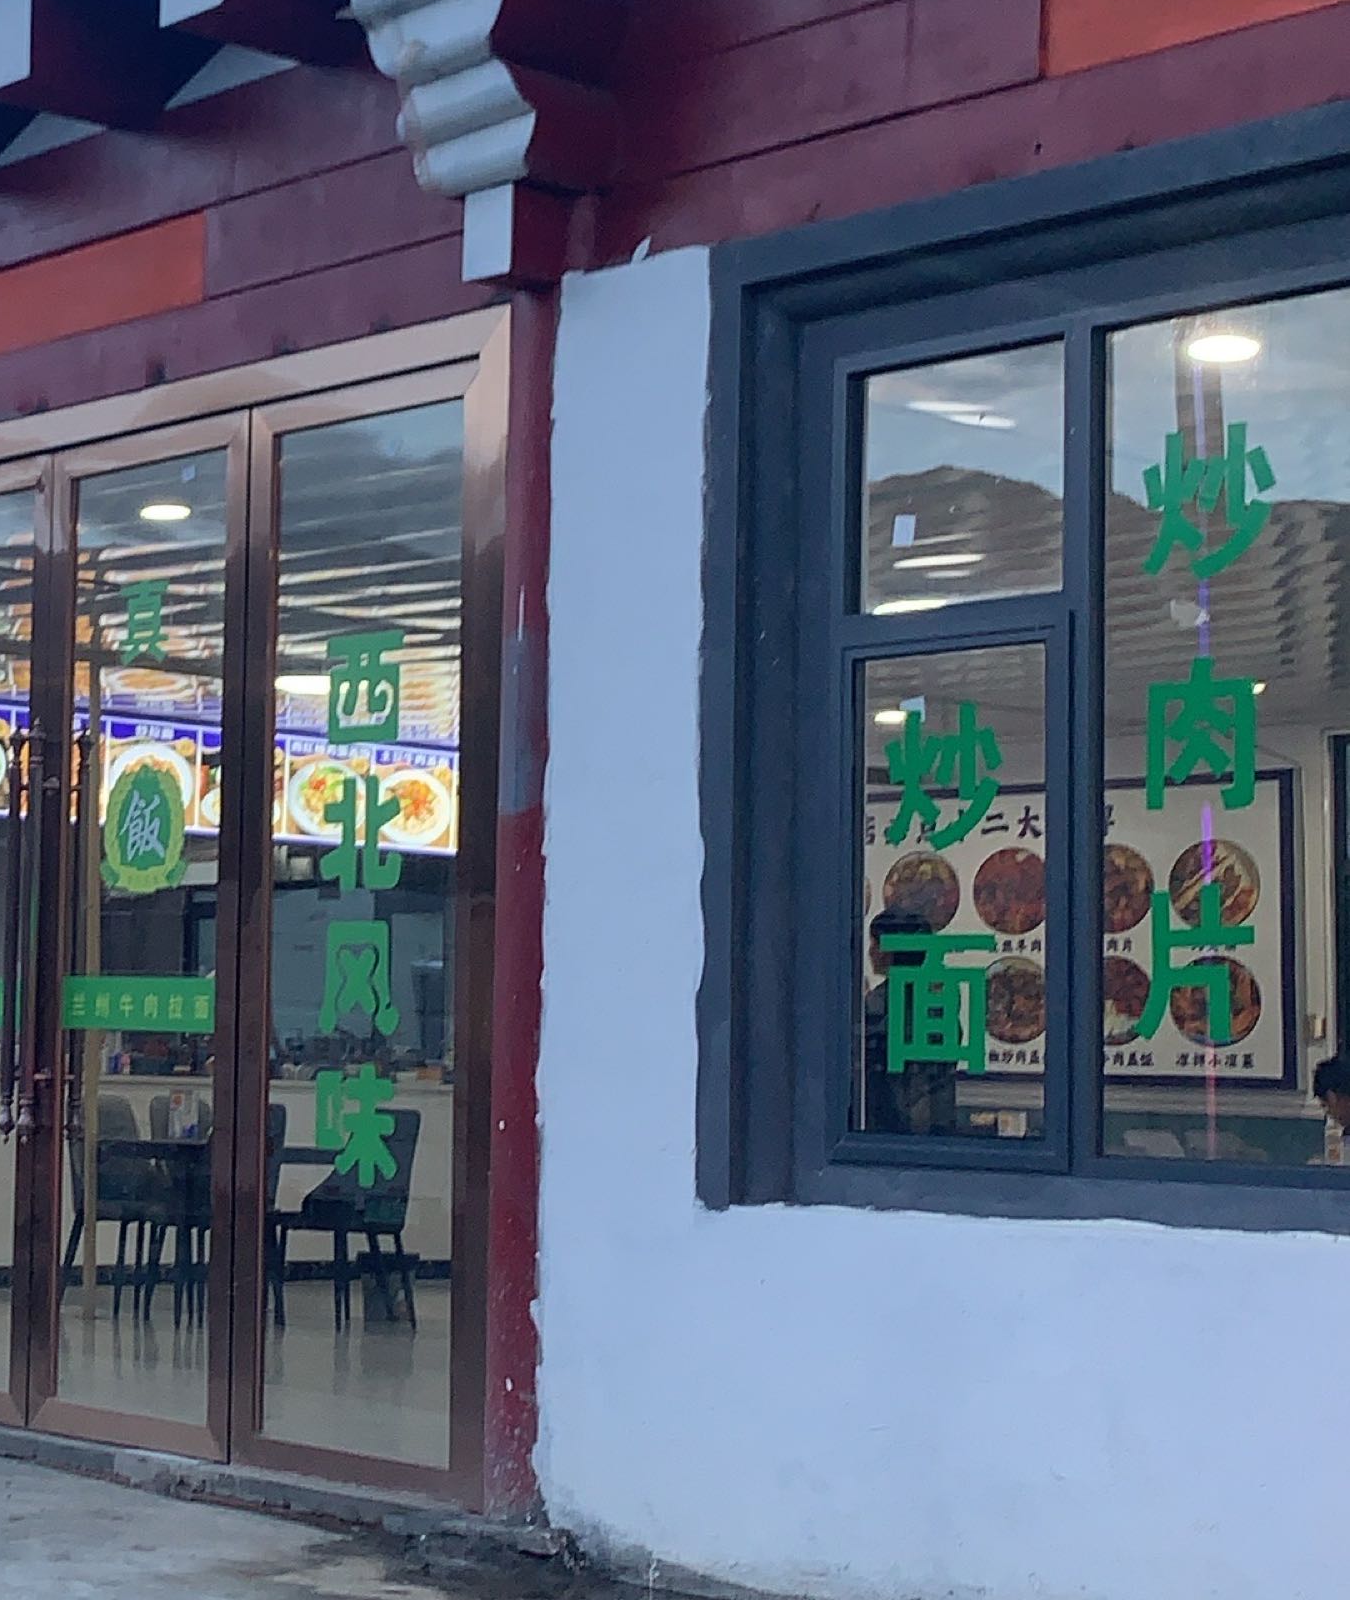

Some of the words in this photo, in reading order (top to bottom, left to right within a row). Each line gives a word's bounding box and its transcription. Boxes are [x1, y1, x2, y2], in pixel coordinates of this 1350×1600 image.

[120, 579, 170, 664] 真
[1138, 422, 1276, 1042] 炒肉片
[72, 992, 210, 1019] 兰州牛肉拉面
[315, 630, 405, 1187] 西北风味
[880, 699, 1005, 1074] 炒面
